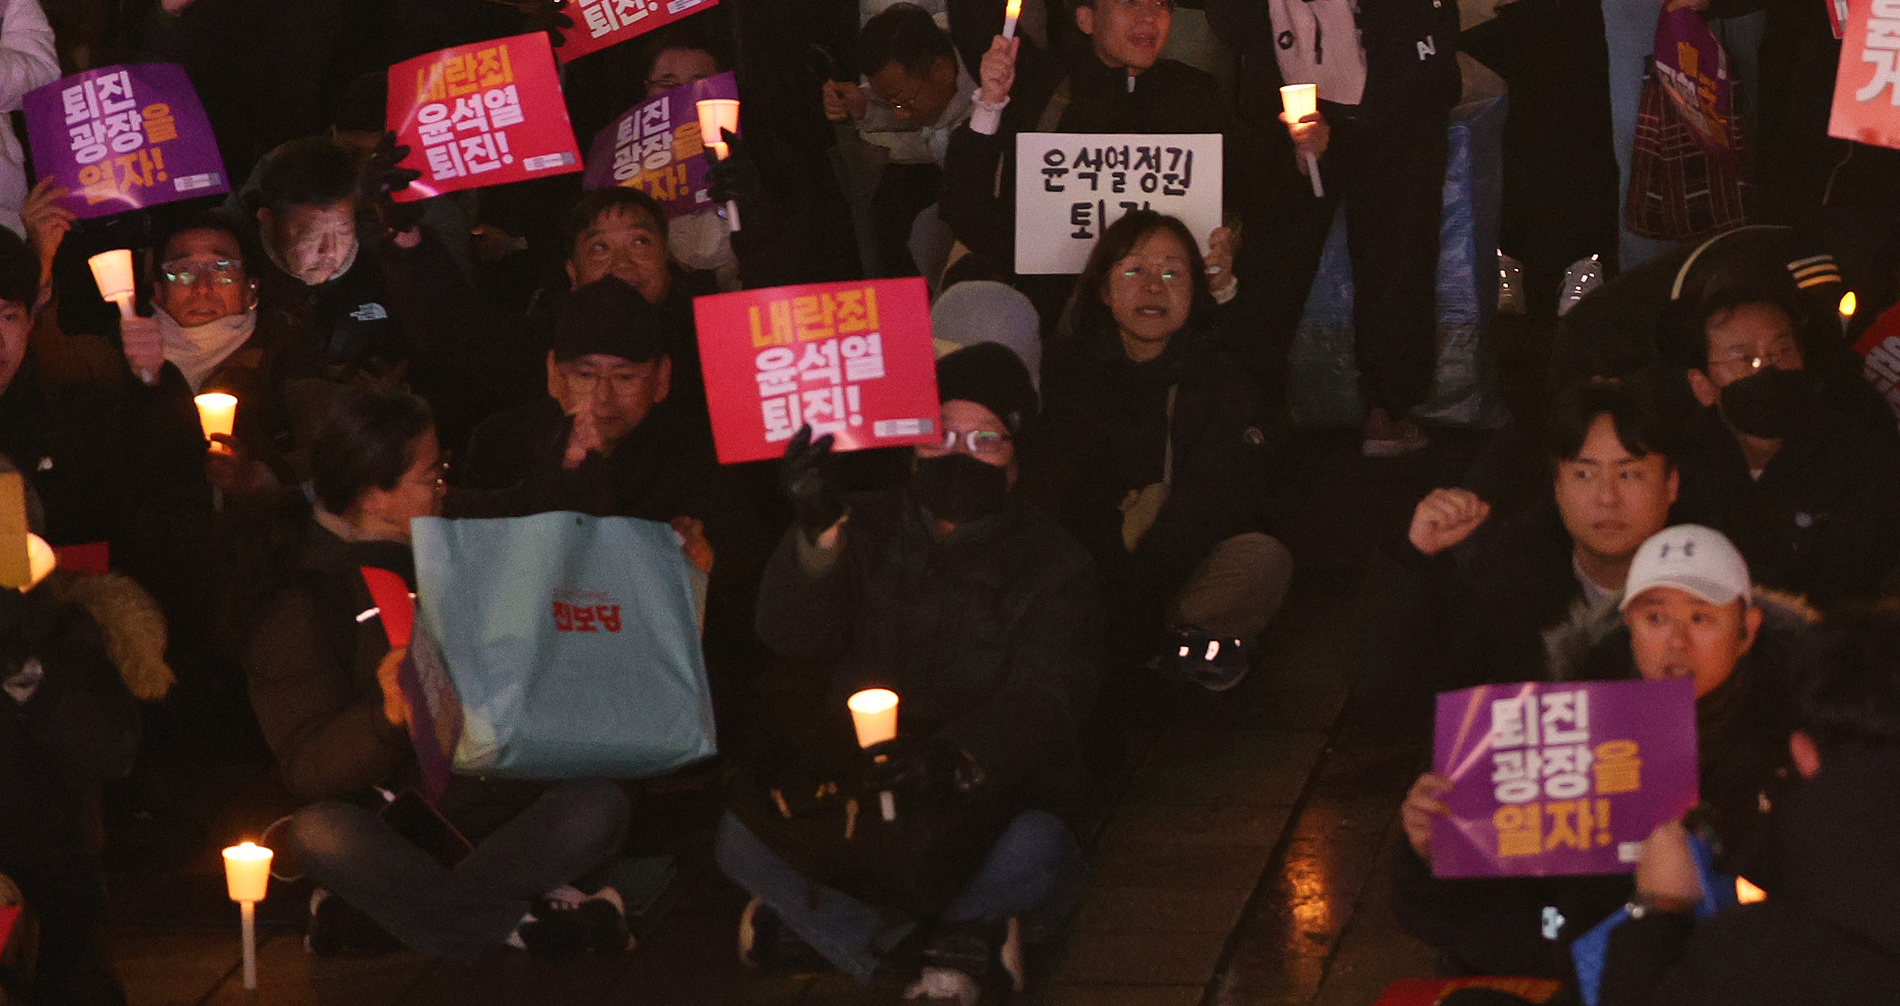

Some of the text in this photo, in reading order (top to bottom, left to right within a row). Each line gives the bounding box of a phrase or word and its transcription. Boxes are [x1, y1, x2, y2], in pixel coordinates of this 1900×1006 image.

[61, 70, 132, 120] 퇴진
[416, 45, 514, 100] 내란죄
[69, 103, 178, 164] 광장을
[416, 85, 524, 144] 윤석열
[615, 97, 670, 147] 퇴진
[76, 147, 168, 205] 열자!
[424, 133, 514, 180] 퇴진!
[747, 286, 881, 350] 내란죄
[752, 333, 886, 392] 윤석열
[761, 386, 863, 444] 퇴진!
[1490, 689, 1592, 750] 퇴진
[1489, 738, 1644, 806] 광장을
[1491, 798, 1612, 860] 열자!
